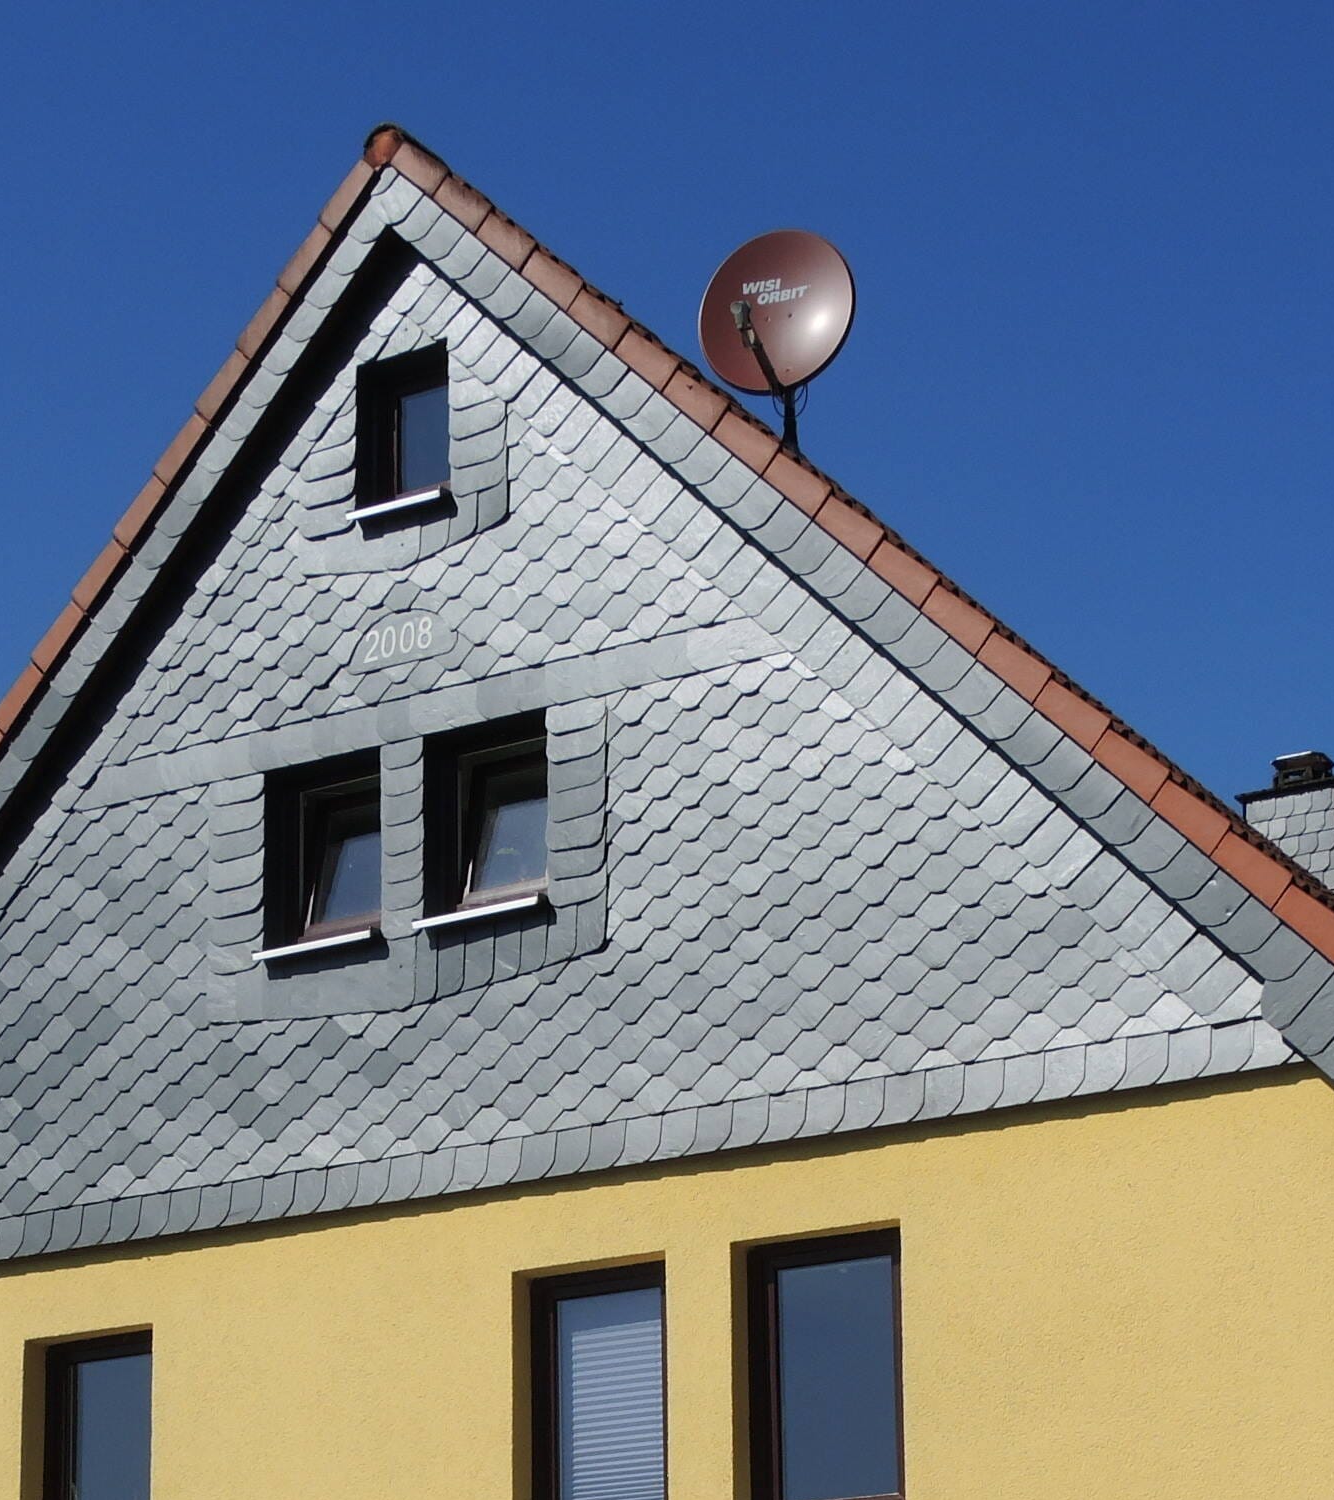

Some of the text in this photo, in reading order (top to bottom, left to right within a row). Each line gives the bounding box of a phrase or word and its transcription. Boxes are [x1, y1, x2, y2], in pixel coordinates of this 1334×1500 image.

[742, 278, 781, 295] WISI
[757, 285, 808, 305] ORBIT
[363, 616, 432, 664] 2008
